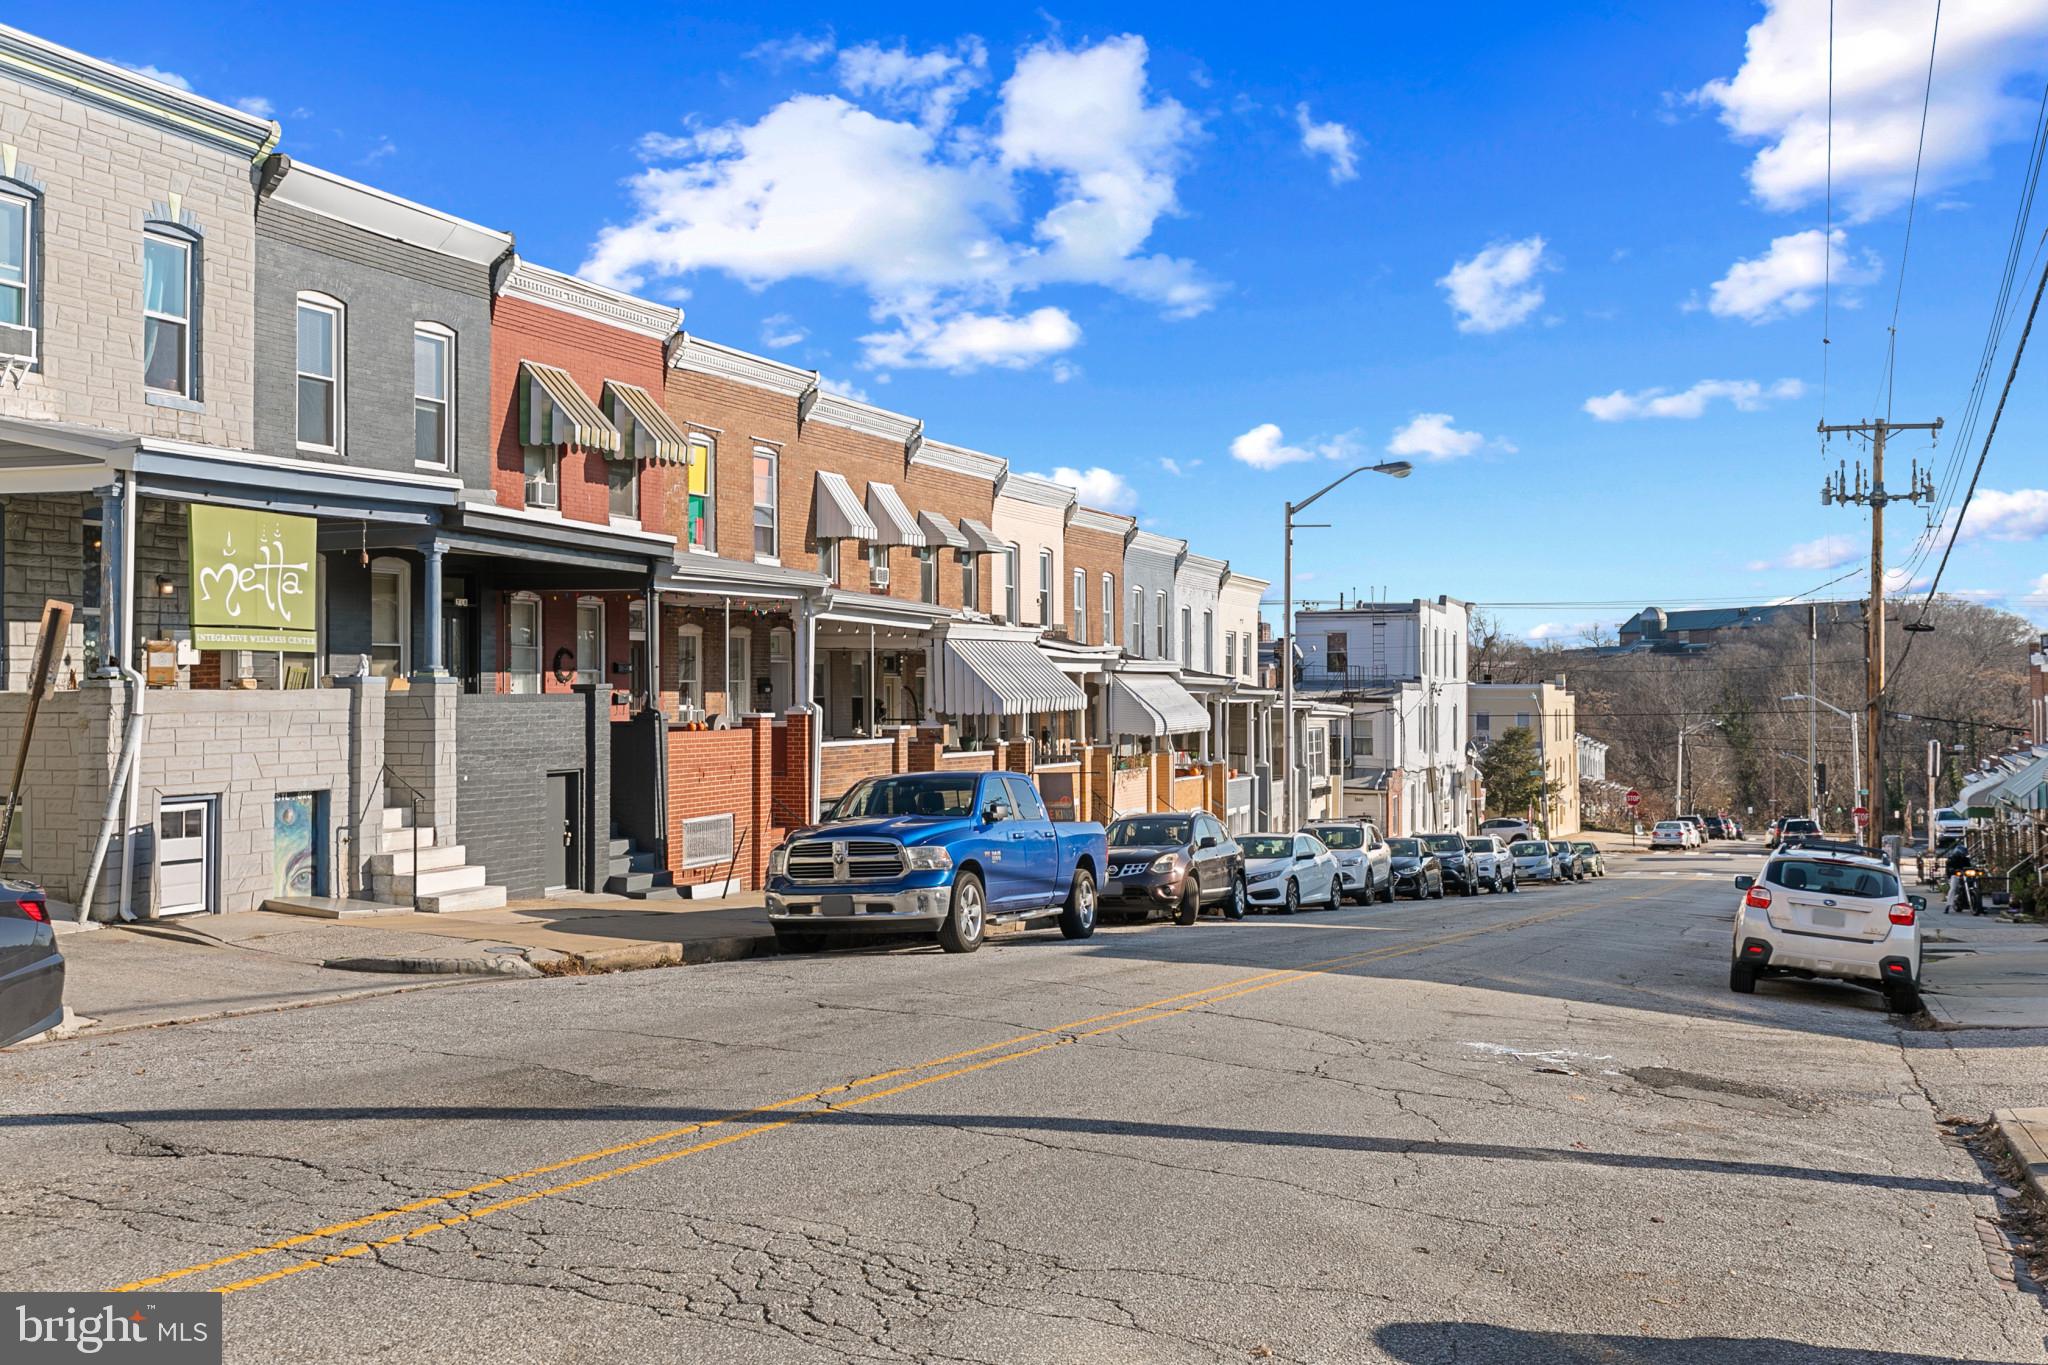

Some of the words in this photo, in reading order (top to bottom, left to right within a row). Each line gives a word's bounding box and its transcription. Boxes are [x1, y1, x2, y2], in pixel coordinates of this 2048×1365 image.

[197, 633, 248, 643] INTEGRATIVE
[249, 635, 286, 644] WELLNESS
[288, 636, 316, 645] CENTER
